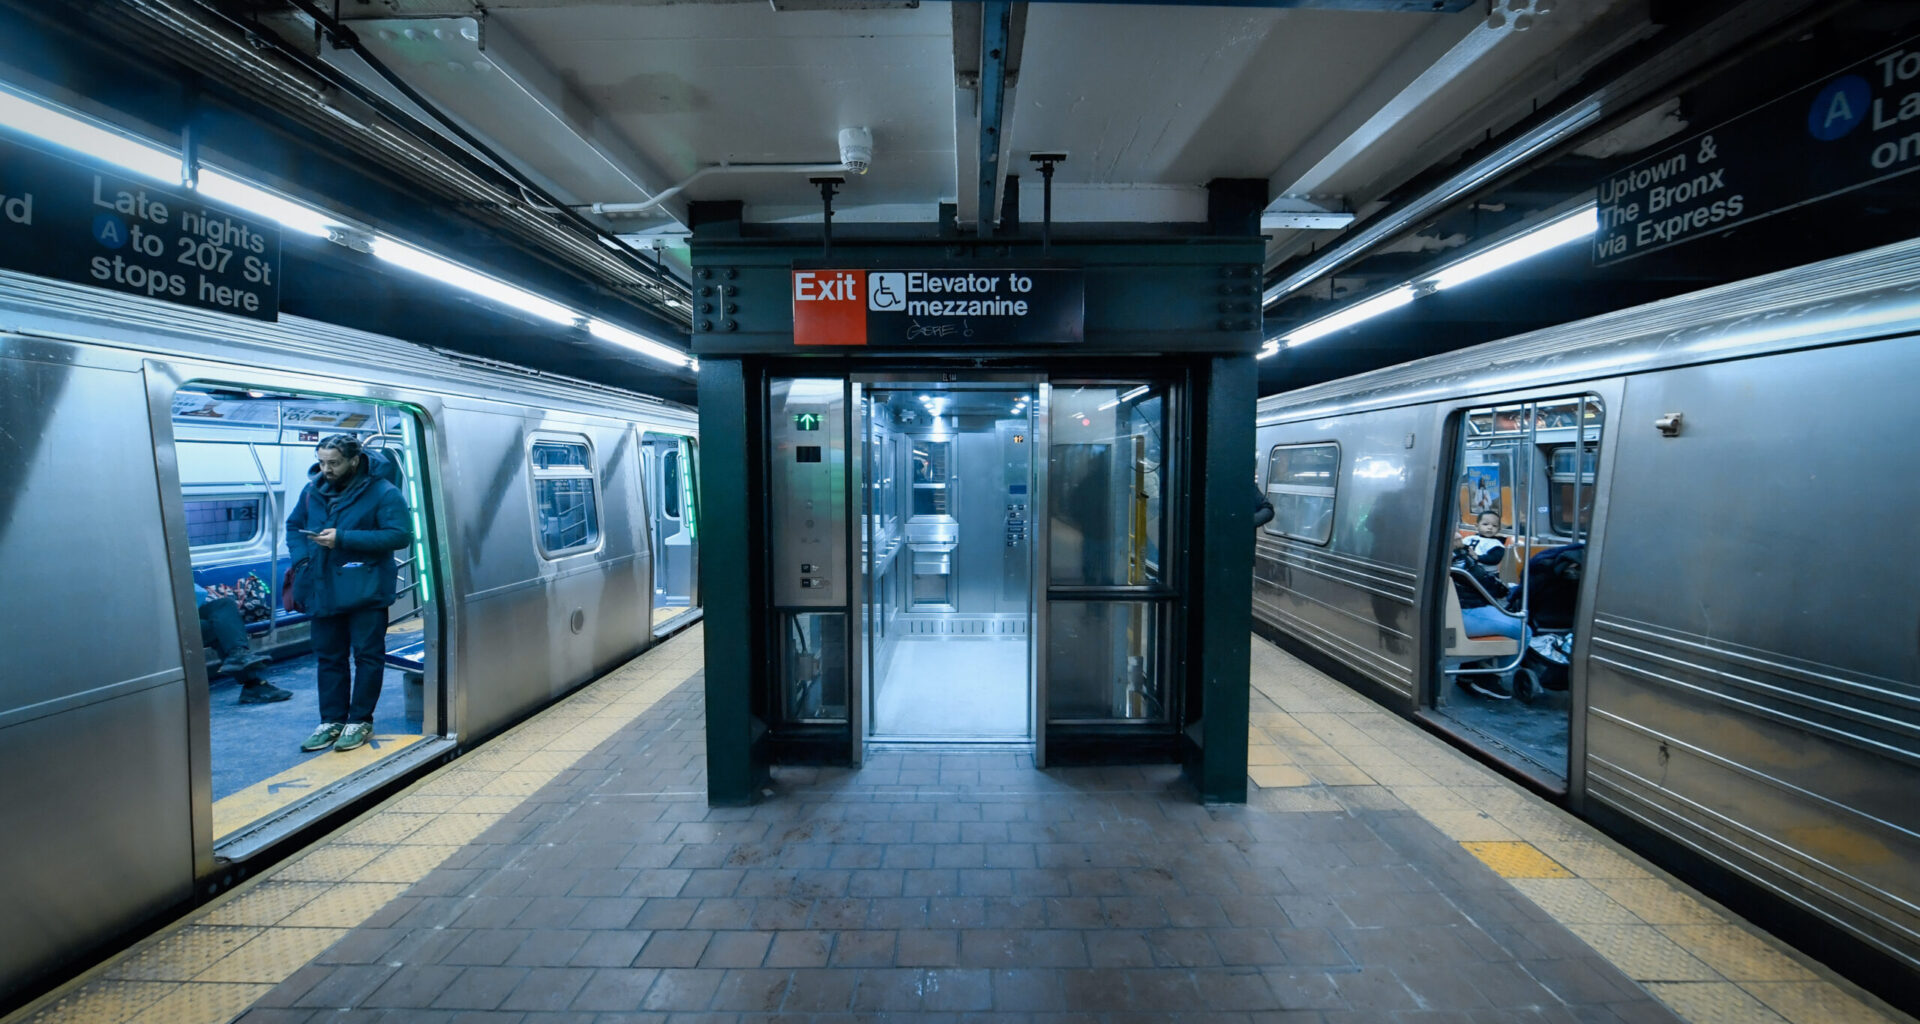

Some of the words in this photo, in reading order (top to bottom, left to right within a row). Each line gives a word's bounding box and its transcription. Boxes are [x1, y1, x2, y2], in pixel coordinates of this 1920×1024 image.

[1824, 91, 1853, 128] A
[1601, 153, 1686, 204] Uptown
[1697, 135, 1717, 164] &
[1601, 203, 1639, 231] The
[1649, 168, 1725, 214] Bronx
[93, 175, 169, 225] Late
[182, 210, 265, 253] nights
[1598, 234, 1627, 258] via
[1636, 195, 1744, 247] Express
[90, 255, 187, 295] stops
[199, 275, 260, 312] here
[102, 221, 119, 242] A
[131, 225, 164, 257] to
[177, 237, 233, 274] 207
[244, 255, 272, 286] St
[908, 272, 999, 293] Elevator
[1009, 273, 1032, 293] to
[795, 273, 856, 301] Exit
[908, 296, 1028, 316] mezzanine
